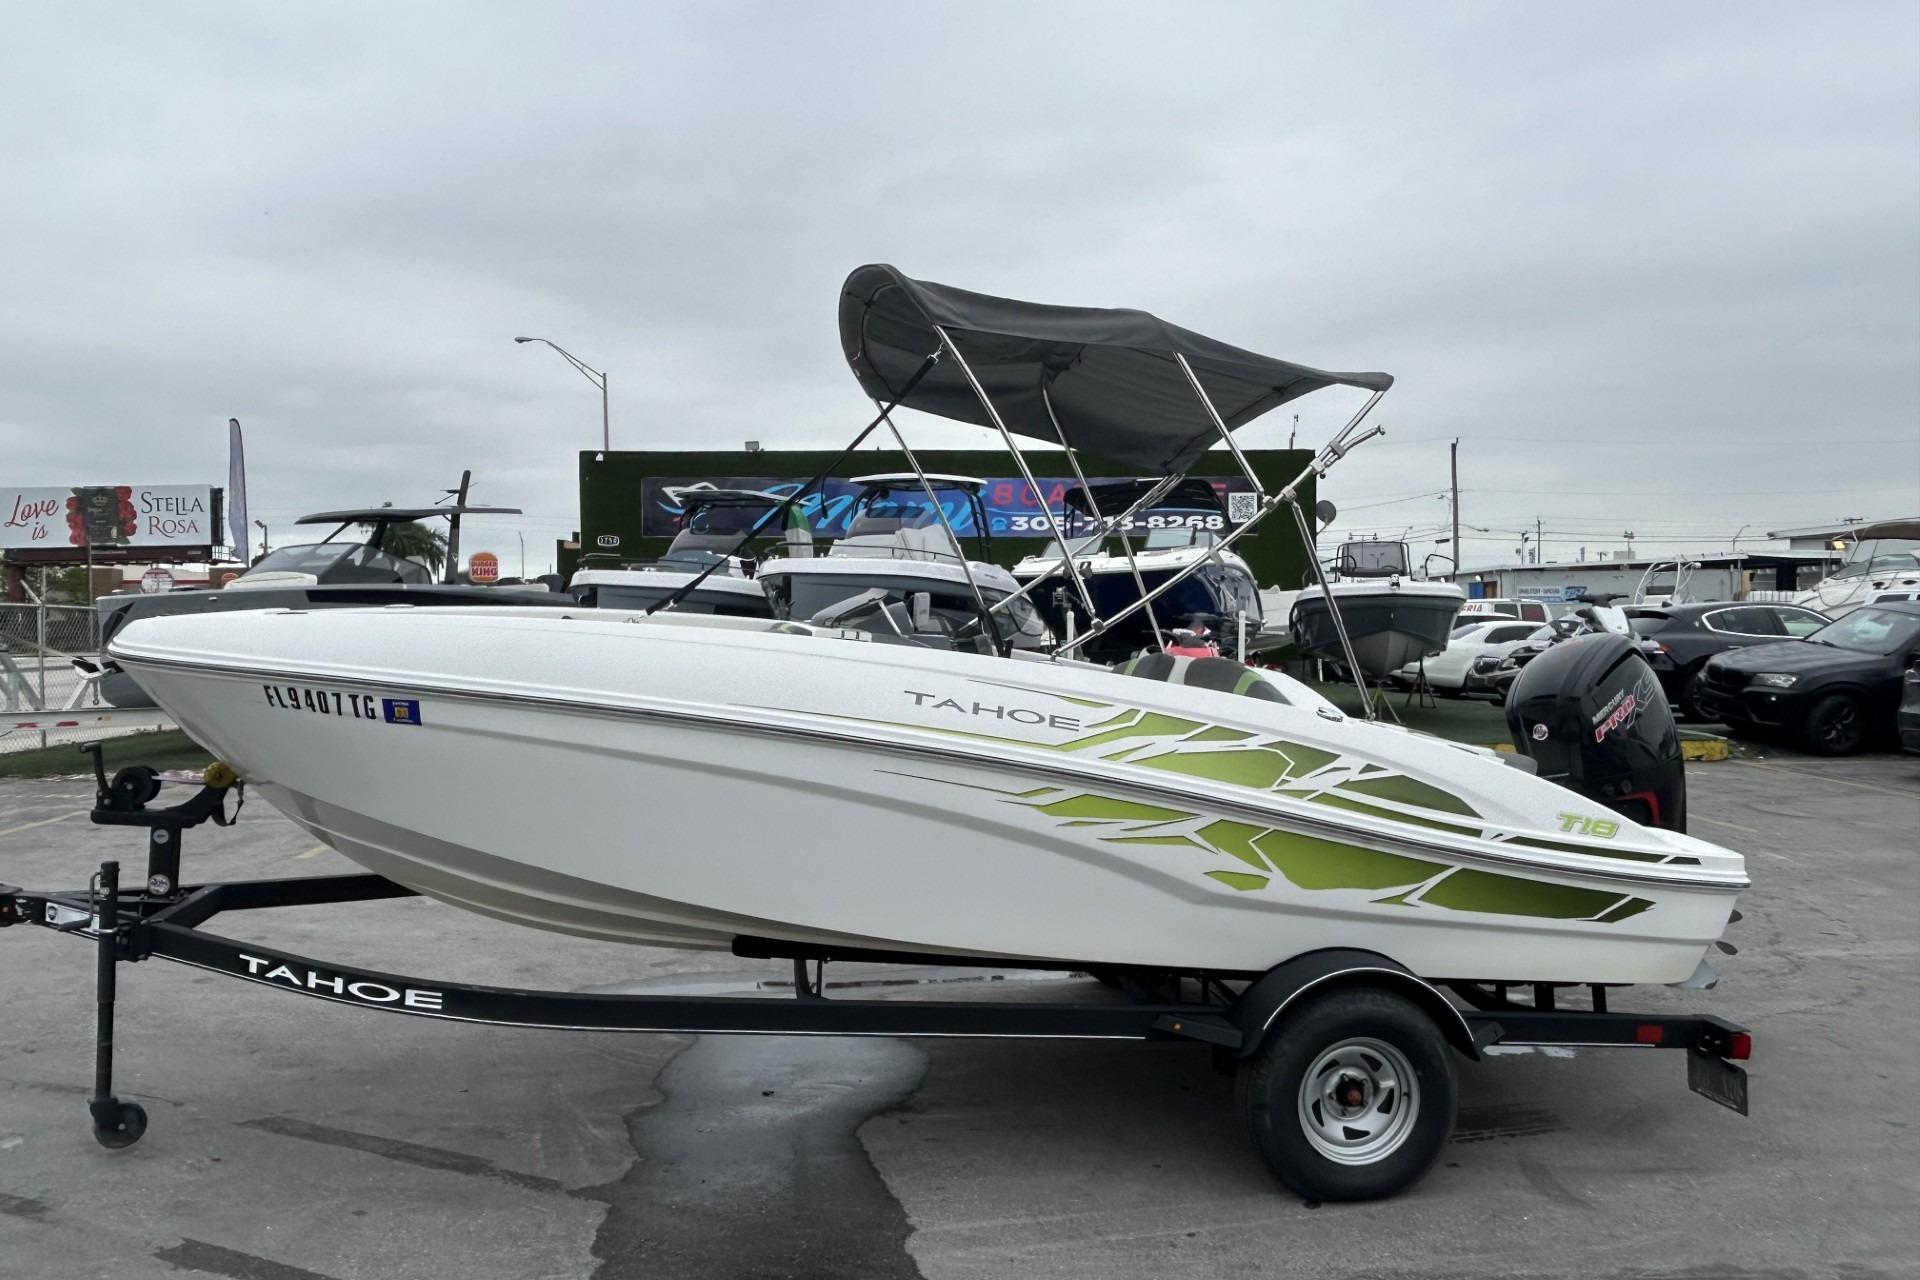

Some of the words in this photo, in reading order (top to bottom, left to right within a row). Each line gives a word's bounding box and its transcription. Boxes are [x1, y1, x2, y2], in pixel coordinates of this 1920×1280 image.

[4, 494, 59, 528] Love
[141, 491, 204, 516] STELLA
[32, 523, 48, 541] is
[149, 516, 199, 539] ROSA
[472, 567, 497, 576] KING
[904, 690, 1080, 732] TAHOE
[1592, 688, 1624, 725] MERCURY
[1557, 811, 1620, 839] T18
[239, 953, 443, 1010] TAHOE
